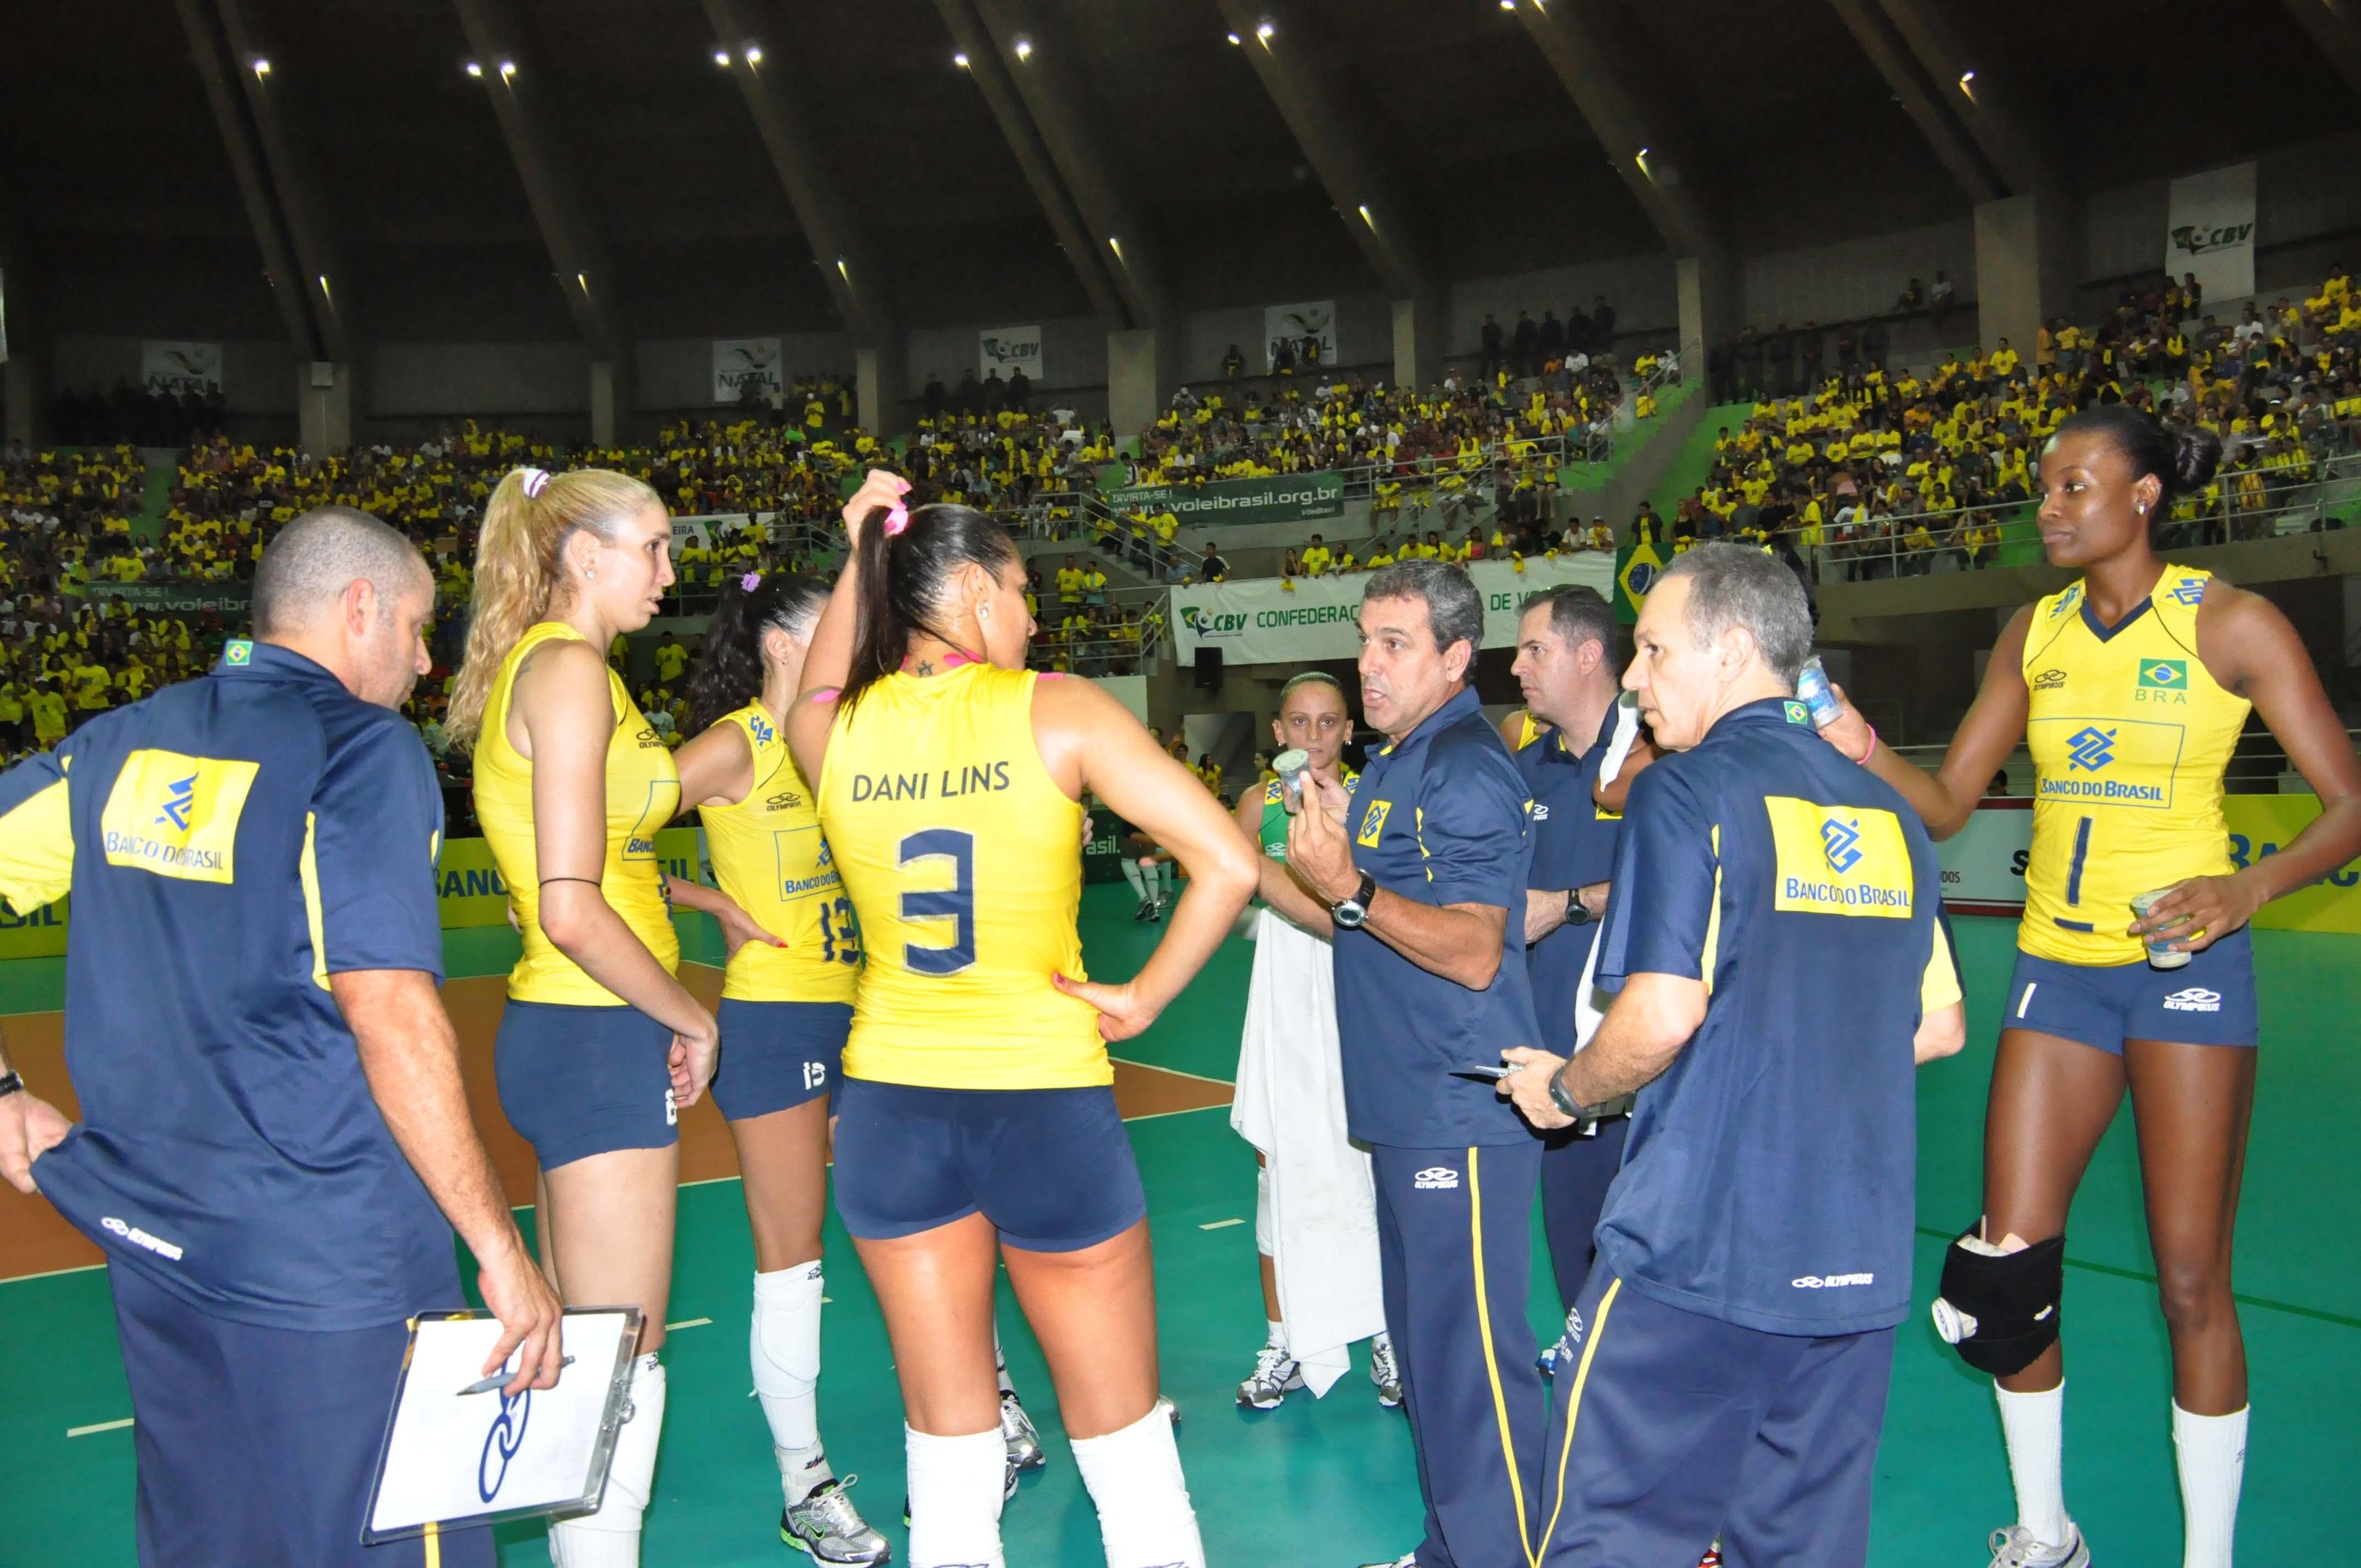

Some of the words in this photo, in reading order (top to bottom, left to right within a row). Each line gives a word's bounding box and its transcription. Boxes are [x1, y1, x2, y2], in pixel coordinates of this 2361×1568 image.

[2209, 223, 2253, 245] CBV
[1214, 613, 1248, 632] CBV
[1491, 592, 1512, 611] DE
[2134, 689, 2187, 705] BRA
[852, 772, 929, 802] DANI
[941, 761, 1010, 798] LINS
[2041, 778, 2080, 796] BANCO
[2082, 782, 2102, 796] DO
[2105, 780, 2164, 801] BRASIL
[184, 847, 224, 870] RASIL
[896, 828, 977, 977] 3
[1786, 878, 1838, 902] BANCO
[1859, 884, 1911, 907] BRASIL
